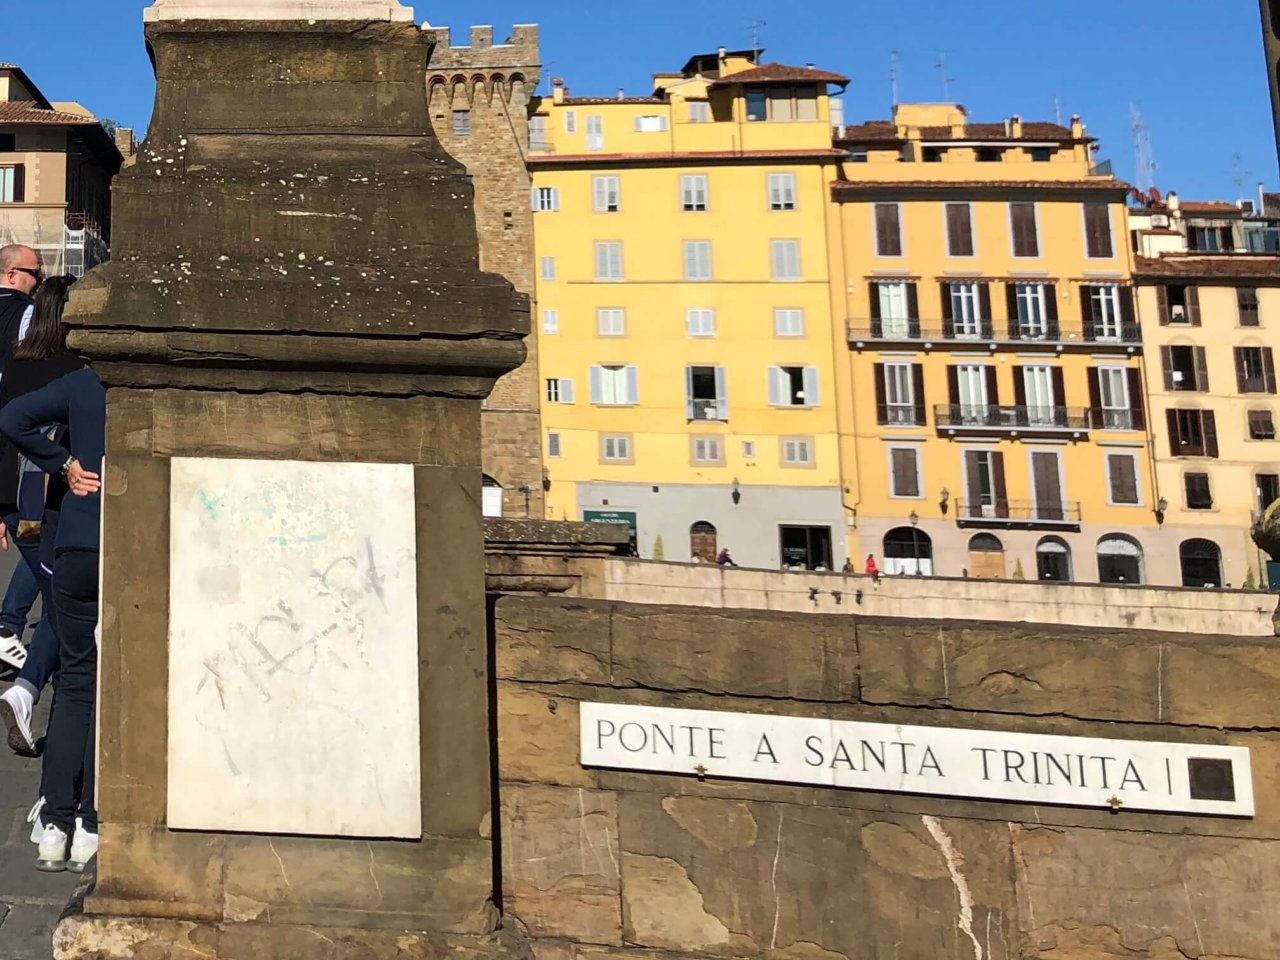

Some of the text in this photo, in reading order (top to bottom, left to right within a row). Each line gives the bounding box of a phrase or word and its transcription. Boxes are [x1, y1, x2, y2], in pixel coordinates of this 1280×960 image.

[596, 719, 1149, 792] PONTE A SANTA TRINITA
